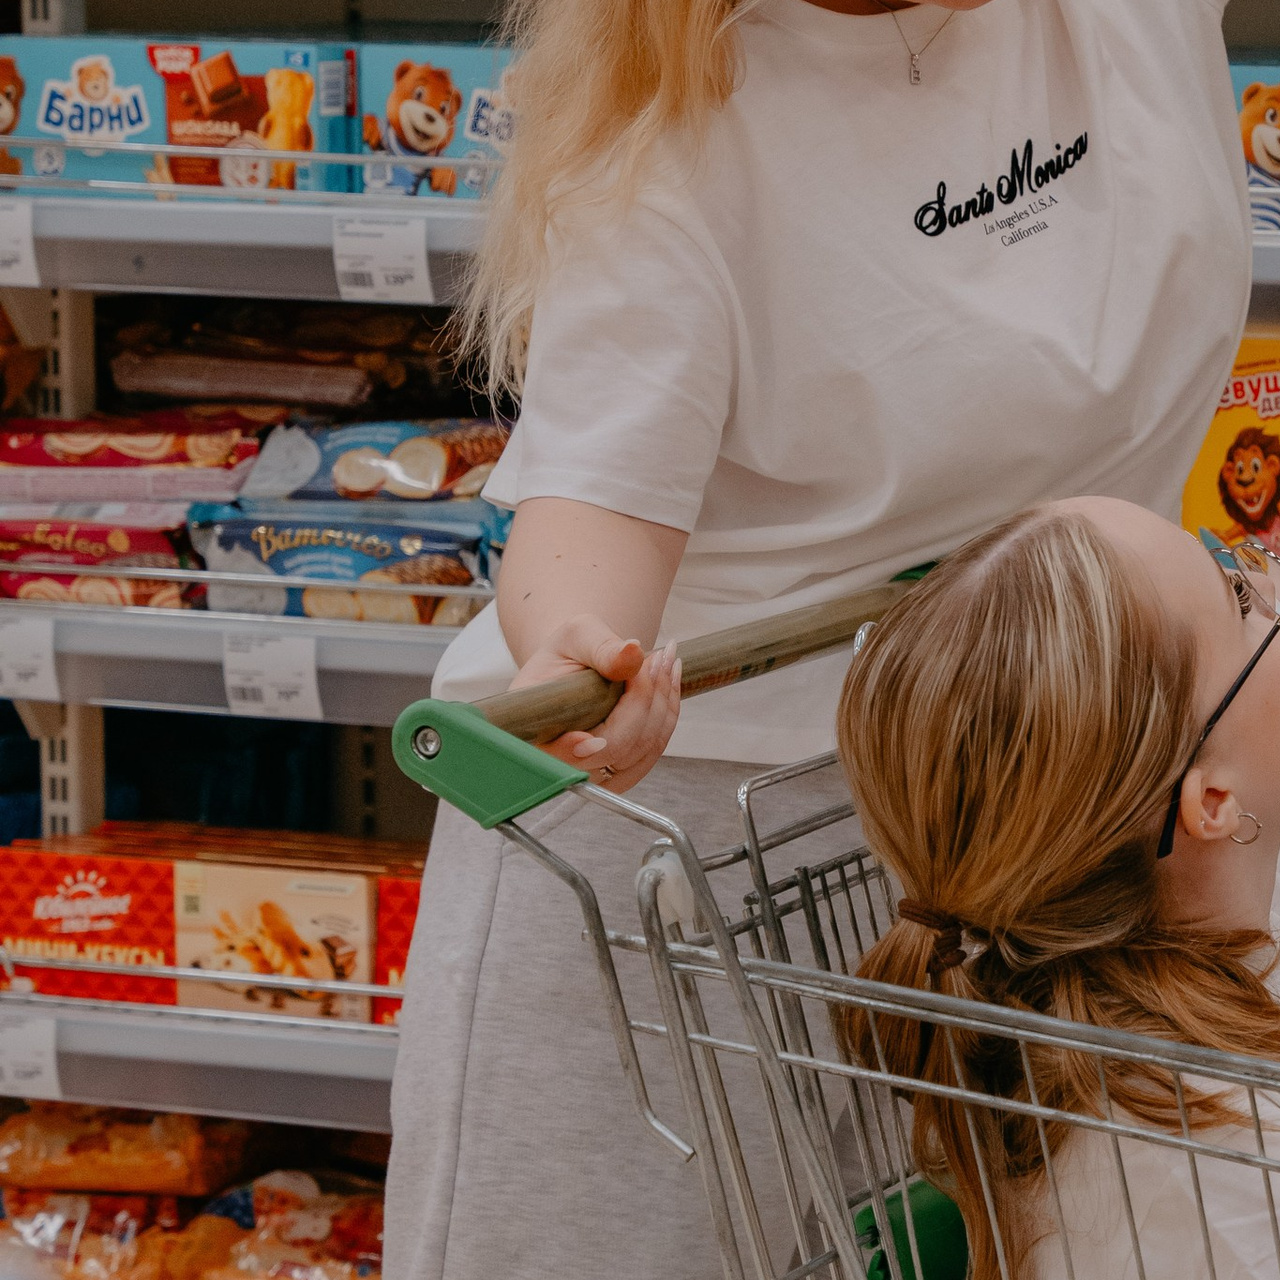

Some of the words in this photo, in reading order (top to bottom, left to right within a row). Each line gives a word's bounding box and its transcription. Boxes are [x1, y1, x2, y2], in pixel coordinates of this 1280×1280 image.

[43, 89, 143, 134] Барни
[914, 181, 994, 237] Santa
[997, 131, 1088, 205] Monica
[995, 209, 1030, 232] Angeles
[1000, 220, 1049, 247] California
